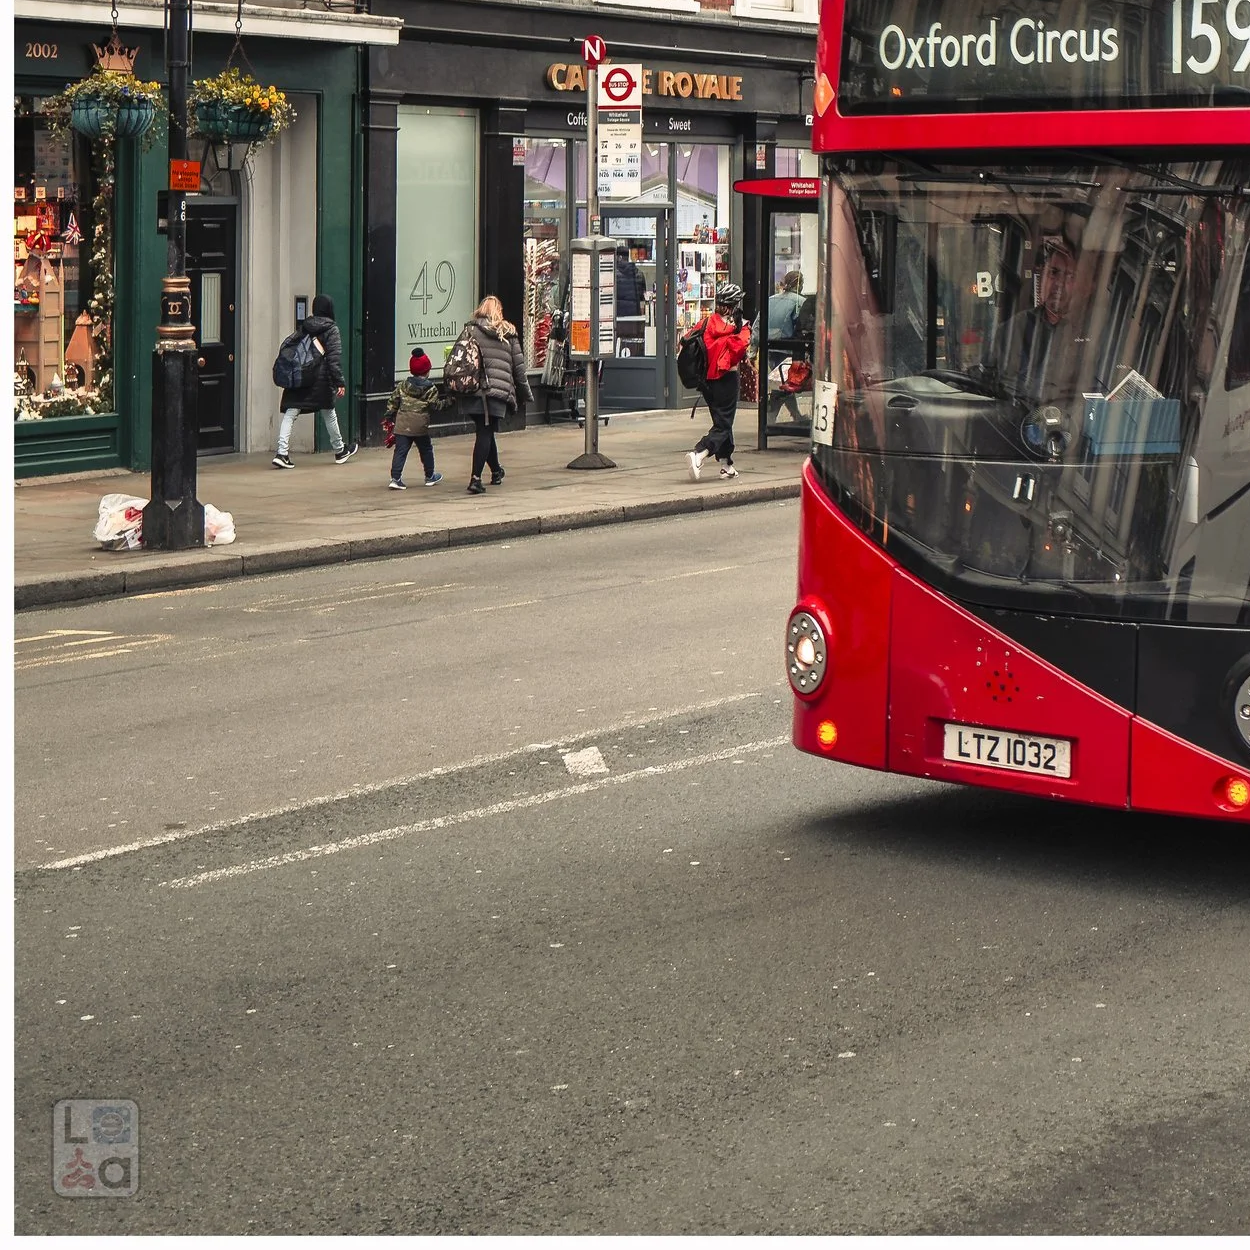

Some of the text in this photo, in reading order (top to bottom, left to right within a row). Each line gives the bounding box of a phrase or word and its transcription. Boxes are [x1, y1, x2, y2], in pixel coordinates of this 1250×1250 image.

[25, 42, 58, 59] 2002
[584, 39, 601, 61] N
[878, 17, 1120, 71] Oxford Circus
[659, 71, 743, 101] ROYALE
[668, 116, 692, 132] Sweet
[409, 260, 456, 315] 49
[407, 321, 457, 339] Whitehall
[815, 404, 828, 432] 13
[958, 731, 1056, 771] LTZ 1032
